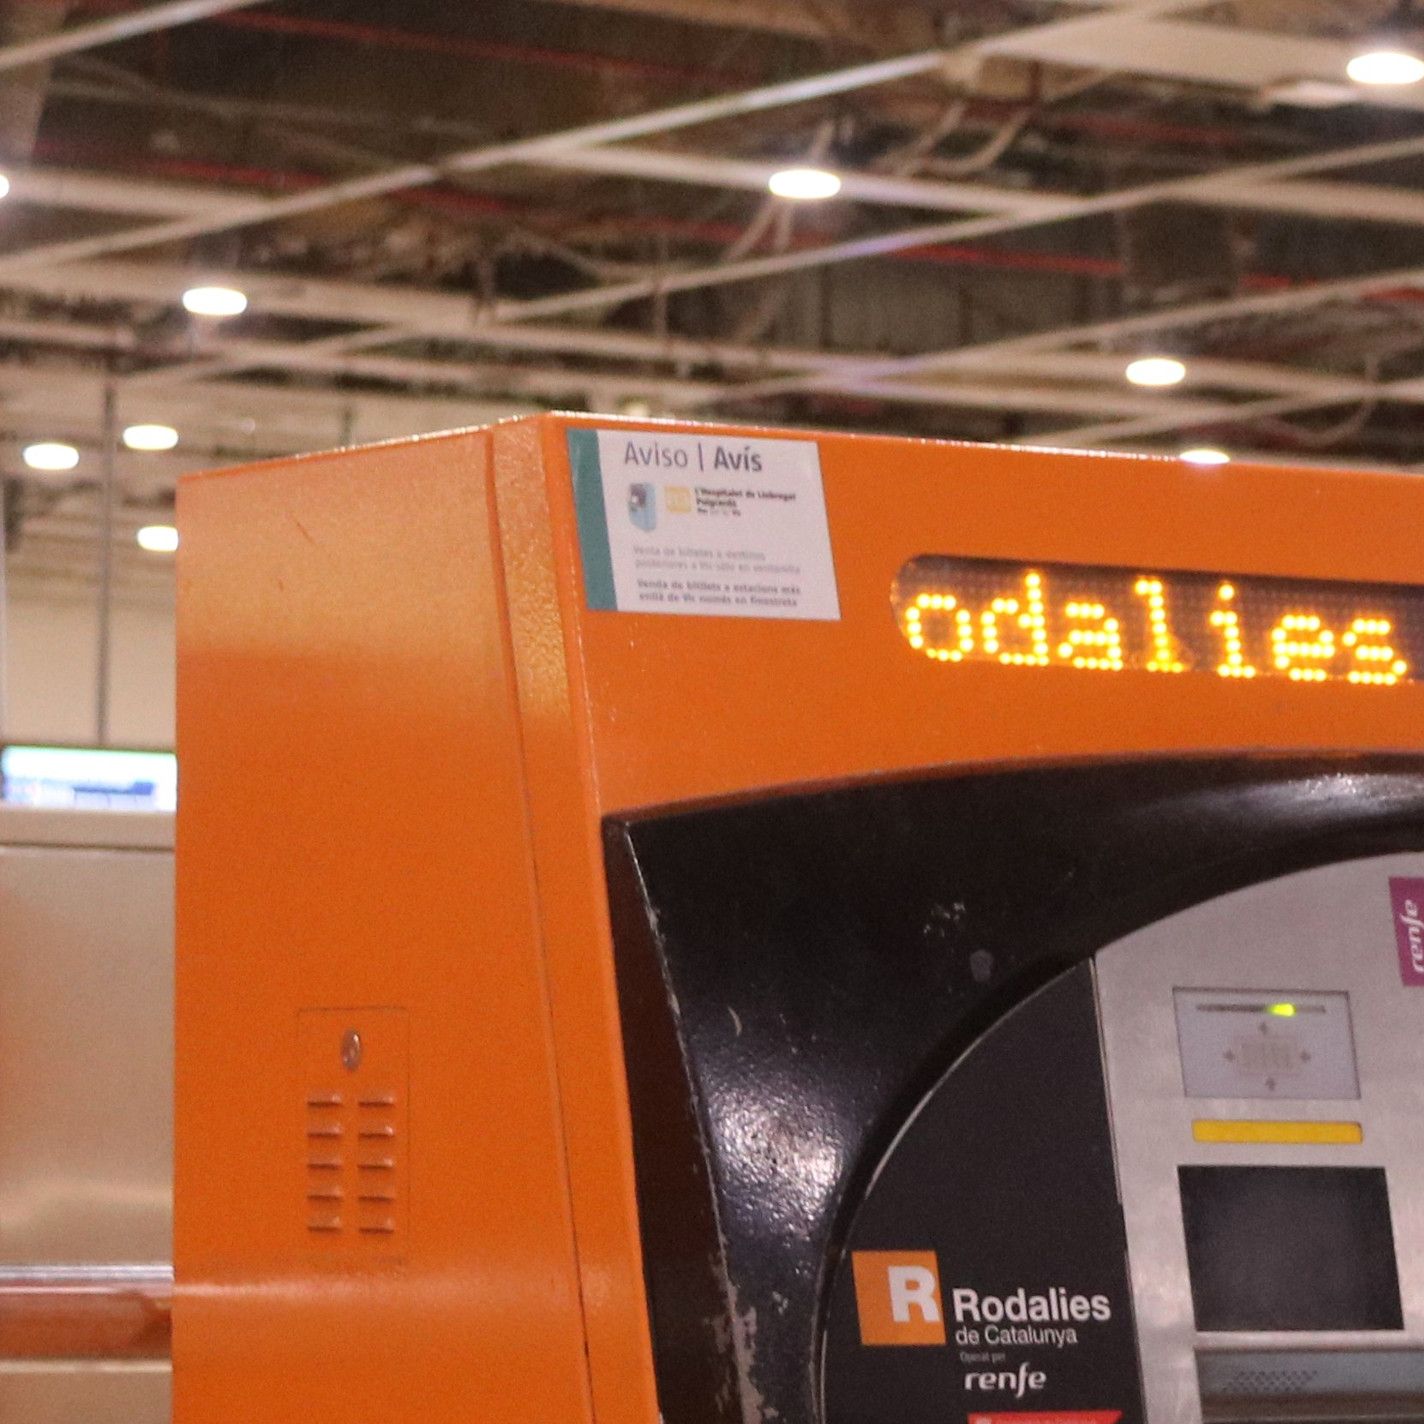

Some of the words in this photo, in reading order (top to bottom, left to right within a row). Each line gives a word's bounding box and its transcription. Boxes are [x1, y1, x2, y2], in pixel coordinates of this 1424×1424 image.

[624, 441, 689, 468] Aviso
[714, 446, 763, 472] Avís
[888, 1265, 942, 1323] R
[952, 1286, 1112, 1323] Rodalies
[955, 1324, 980, 1344] de
[984, 1324, 1079, 1348] Catalunya
[964, 1361, 1047, 1399] renfe
